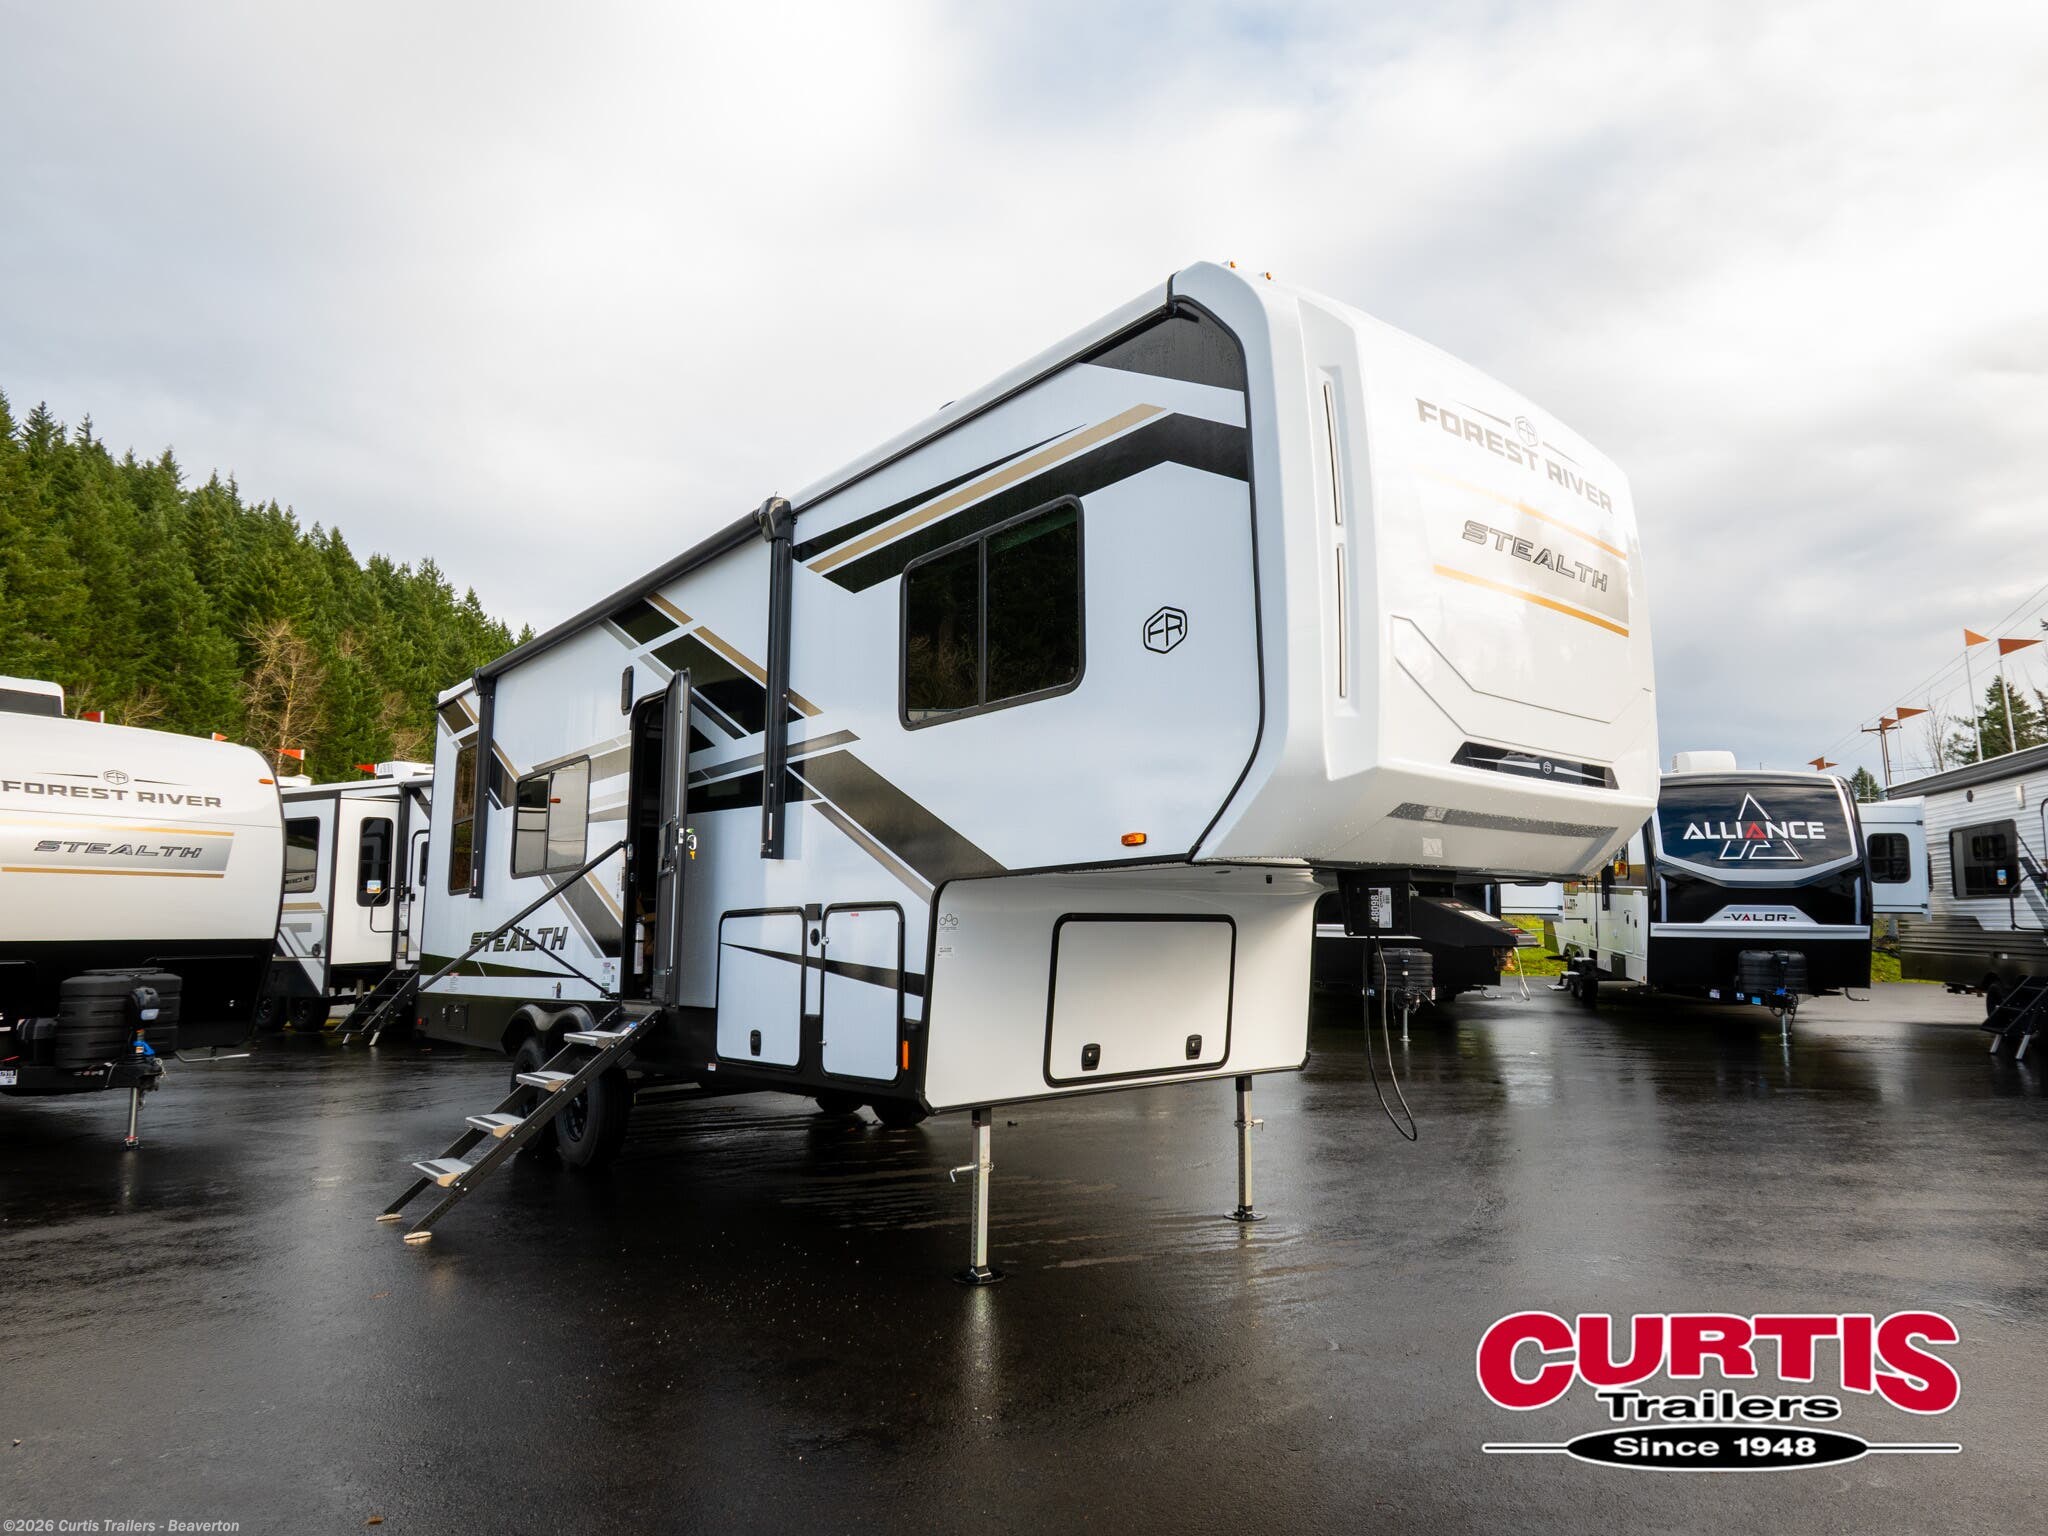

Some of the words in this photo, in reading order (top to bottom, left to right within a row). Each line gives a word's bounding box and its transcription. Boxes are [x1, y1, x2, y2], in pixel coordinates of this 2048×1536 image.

[1415, 399, 1539, 471] FOREST
[1546, 459, 1614, 514] RIVER
[1462, 519, 1608, 593] STEALTH
[1, 780, 129, 801] FOREST
[137, 791, 222, 808] RIVER
[1683, 821, 1826, 840] ALLIANCE
[34, 840, 203, 859] STEALTH
[469, 927, 568, 952] STEALTH
